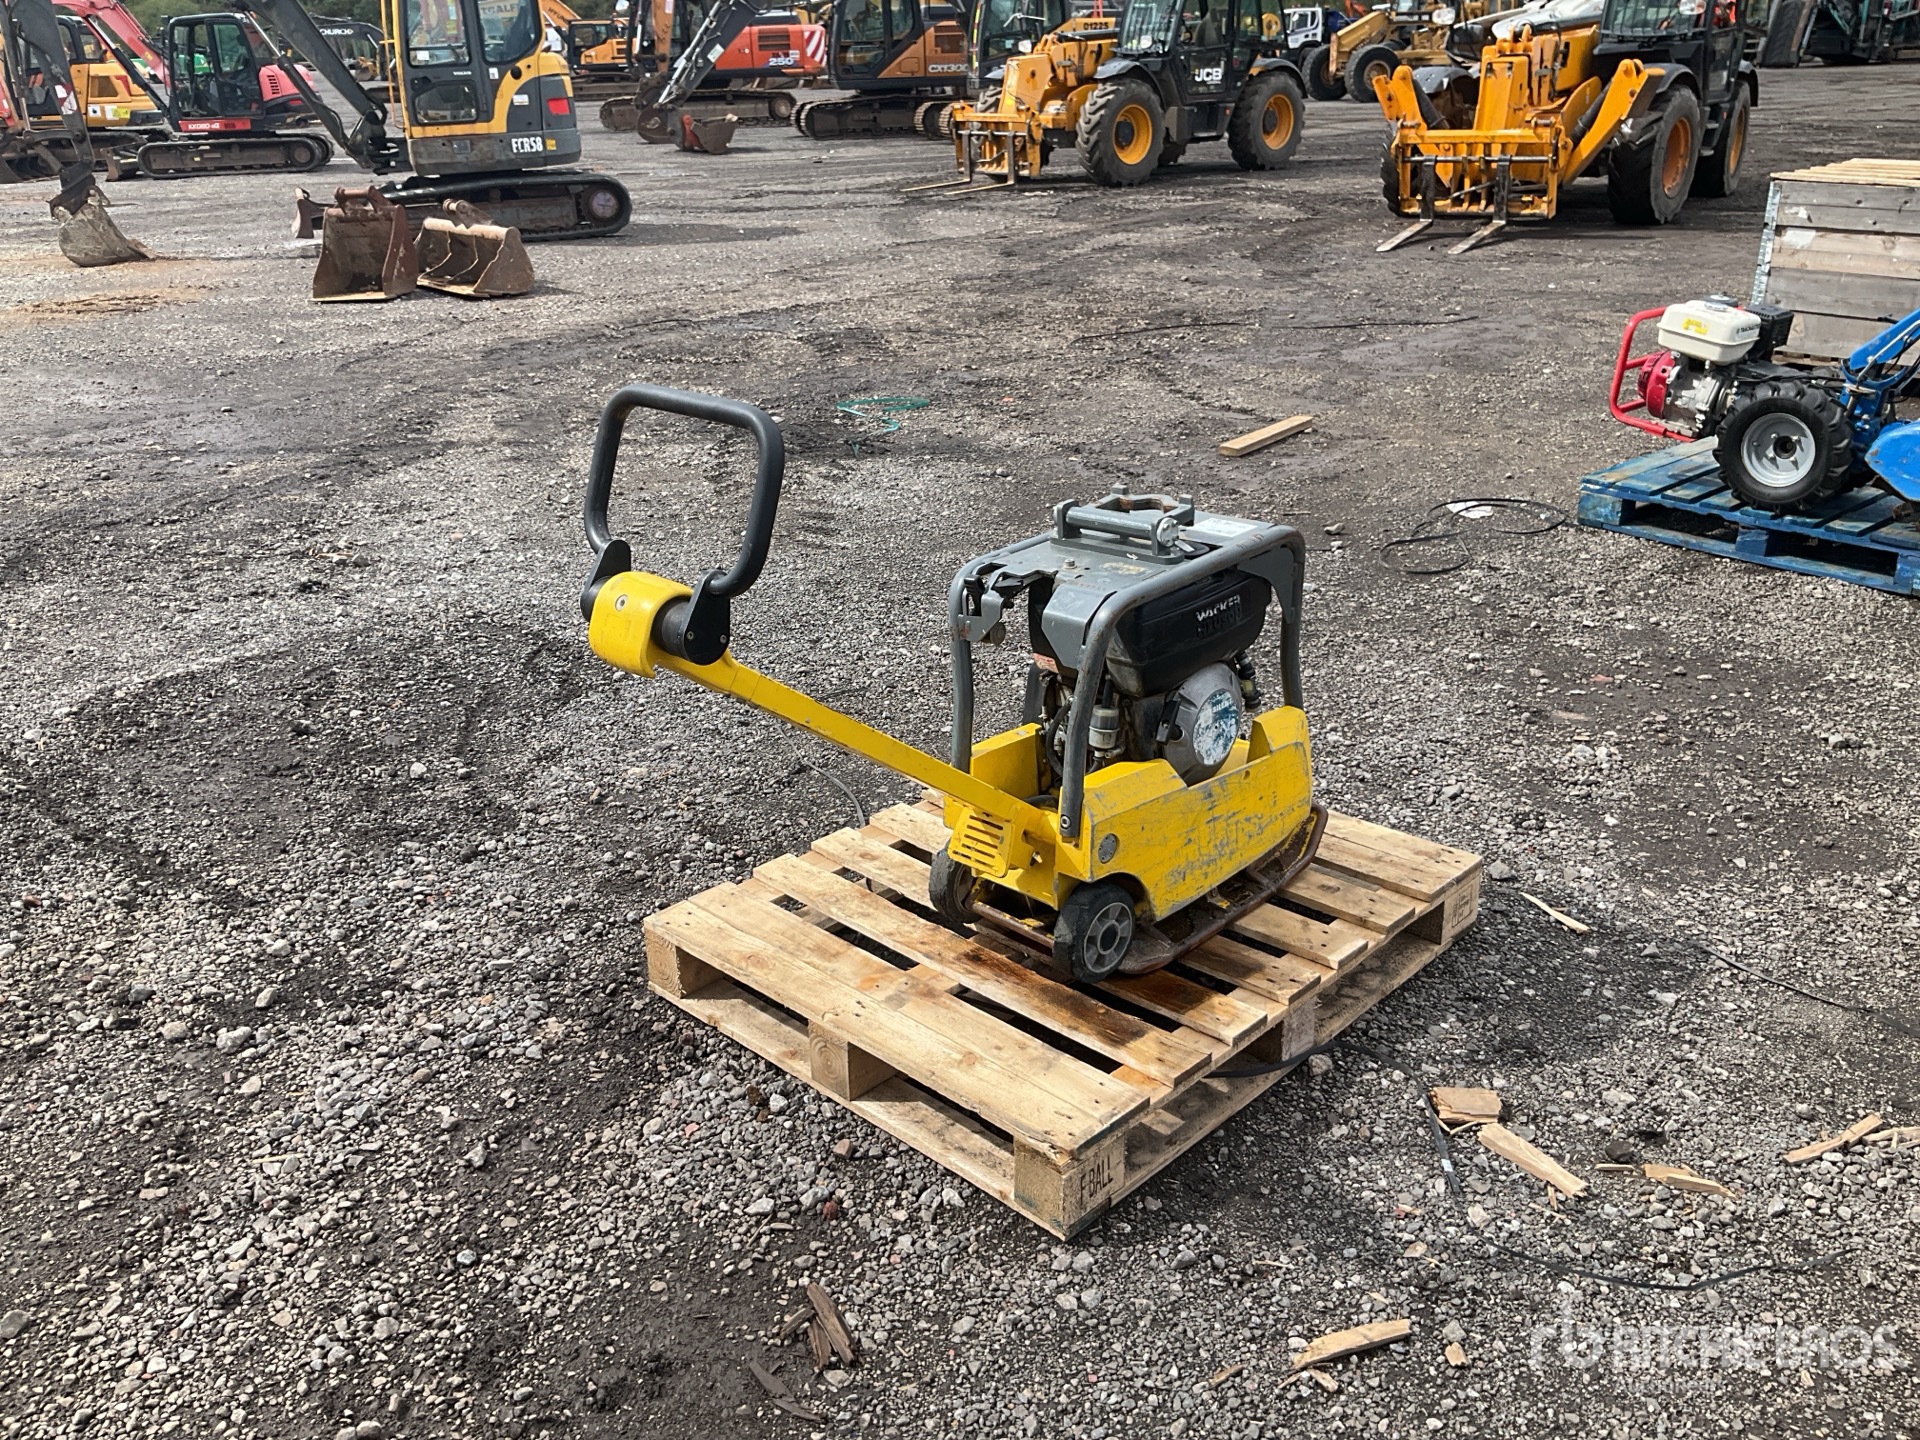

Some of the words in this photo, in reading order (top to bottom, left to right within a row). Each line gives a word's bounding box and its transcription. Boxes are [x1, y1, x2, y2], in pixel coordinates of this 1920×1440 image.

[769, 57, 794, 66] 250
[1194, 67, 1222, 82] JCB
[1088, 1154, 1114, 1199] BALL
